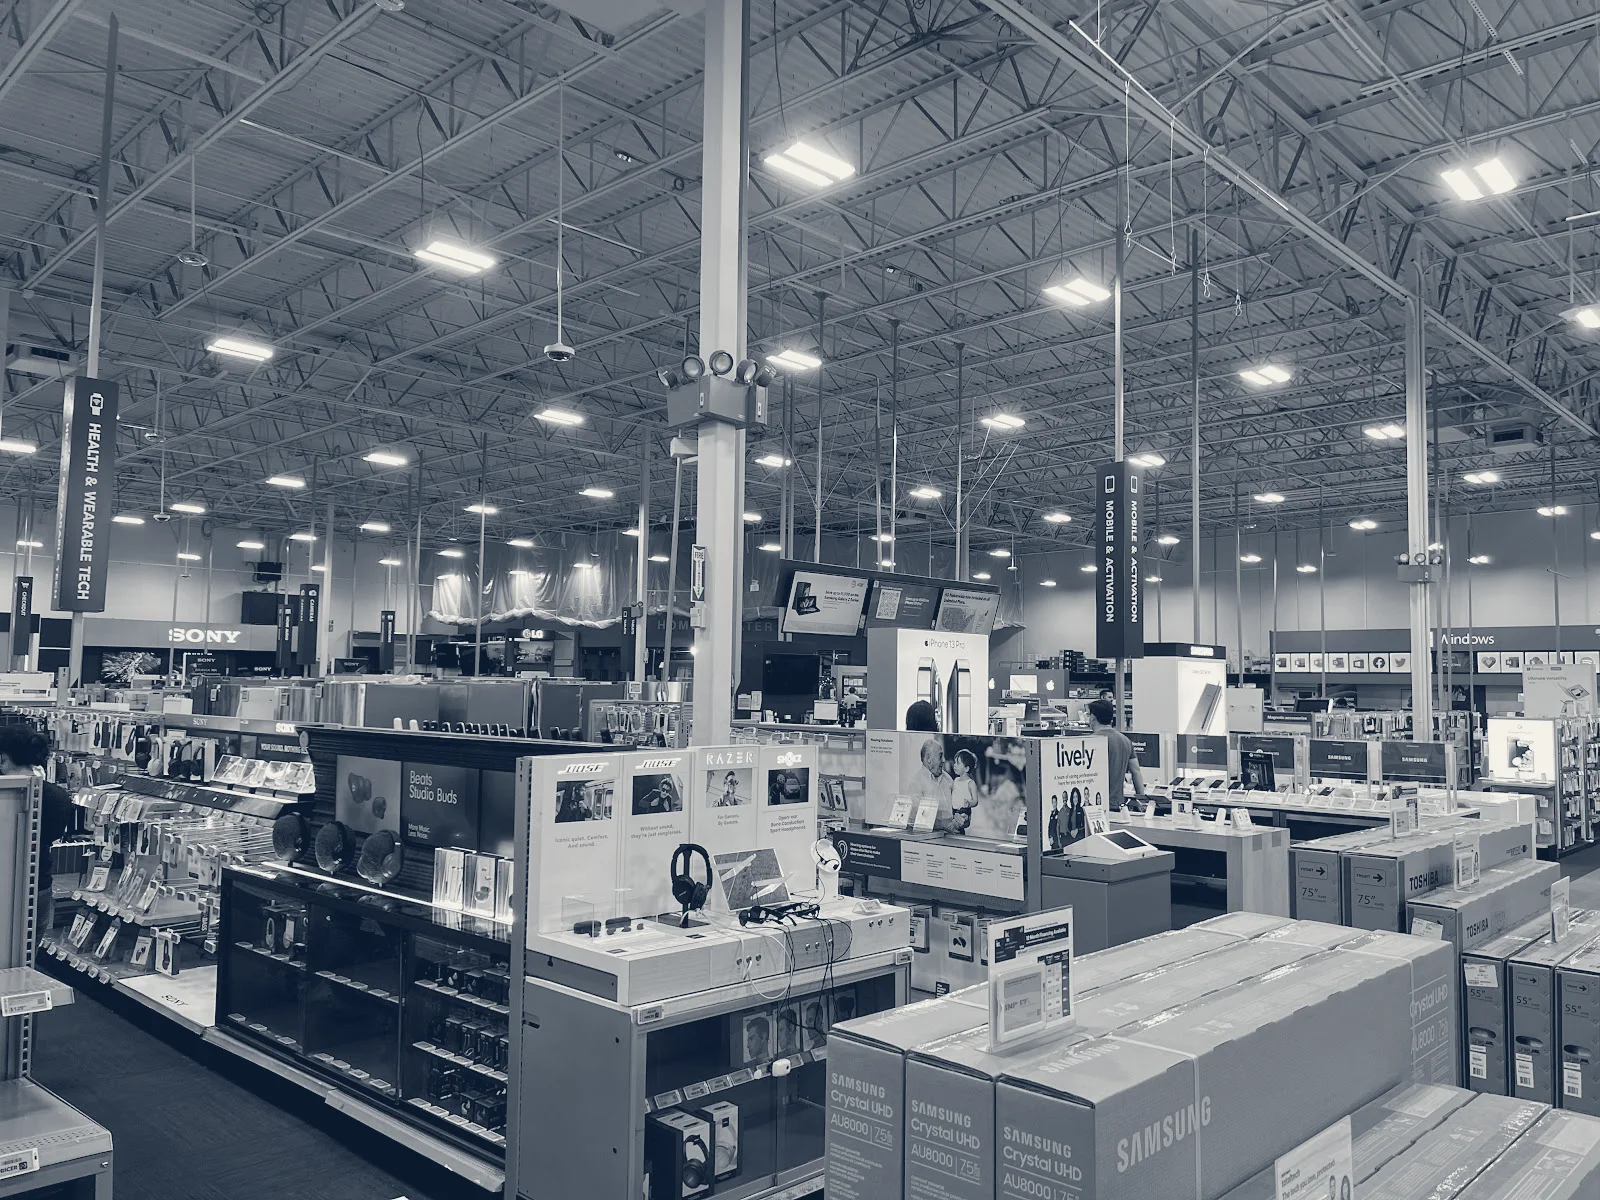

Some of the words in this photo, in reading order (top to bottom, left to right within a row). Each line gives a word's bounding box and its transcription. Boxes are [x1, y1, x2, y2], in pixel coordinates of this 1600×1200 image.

[86, 422, 101, 472] HEALTH
[85, 476, 98, 487] &
[80, 492, 97, 562] WEARABLE
[1106, 500, 1114, 542] MOBILE
[1106, 546, 1114, 555] &
[1131, 546, 1138, 554] &
[77, 566, 91, 601] TECH
[1106, 557, 1115, 622] ACTIVATION
[532, 630, 543, 638] LG
[658, 620, 688, 630] HOM
[169, 628, 241, 644] SONY
[929, 639, 949, 648] iPhone
[949, 641, 955, 649] 13
[956, 641, 966, 649] Pro
[192, 718, 208, 726] SONY
[559, 763, 609, 775] BOSE
[637, 758, 681, 769] BOSE
[706, 752, 753, 765] RAZER
[410, 770, 433, 786] Beats
[409, 784, 435, 801] Studio
[437, 788, 458, 804] Buds
[417, 831, 428, 840] Noise.
[419, 824, 431, 833] Music.
[1409, 870, 1439, 891] TOSHIBA
[1466, 918, 1489, 939] TOSHIBA
[1410, 990, 1434, 1019] Crystal
[1435, 984, 1448, 1004] UHD
[1039, 1044, 1121, 1073] SAMSUNG
[832, 1072, 885, 1099] SAMSUNG
[831, 1090, 869, 1108] Crystal
[872, 1101, 893, 1118] UHD
[912, 1100, 972, 1128] SAMSUNG
[831, 1113, 869, 1136] AU8000
[911, 1118, 954, 1142] Crystal
[956, 1133, 981, 1150] UHD
[1117, 1096, 1211, 1173] SAMSUNG
[1004, 1126, 1072, 1159] SAMSUNG
[911, 1144, 953, 1168] AU8000
[1003, 1146, 1051, 1172] Crystal
[1054, 1163, 1083, 1182] UHD
[1004, 1173, 1051, 1200] AU8000
[1282, 1169, 1300, 1187] totaltech
[1291, 1184, 1300, 1196] tech
[1300, 1180, 1308, 1189] you
